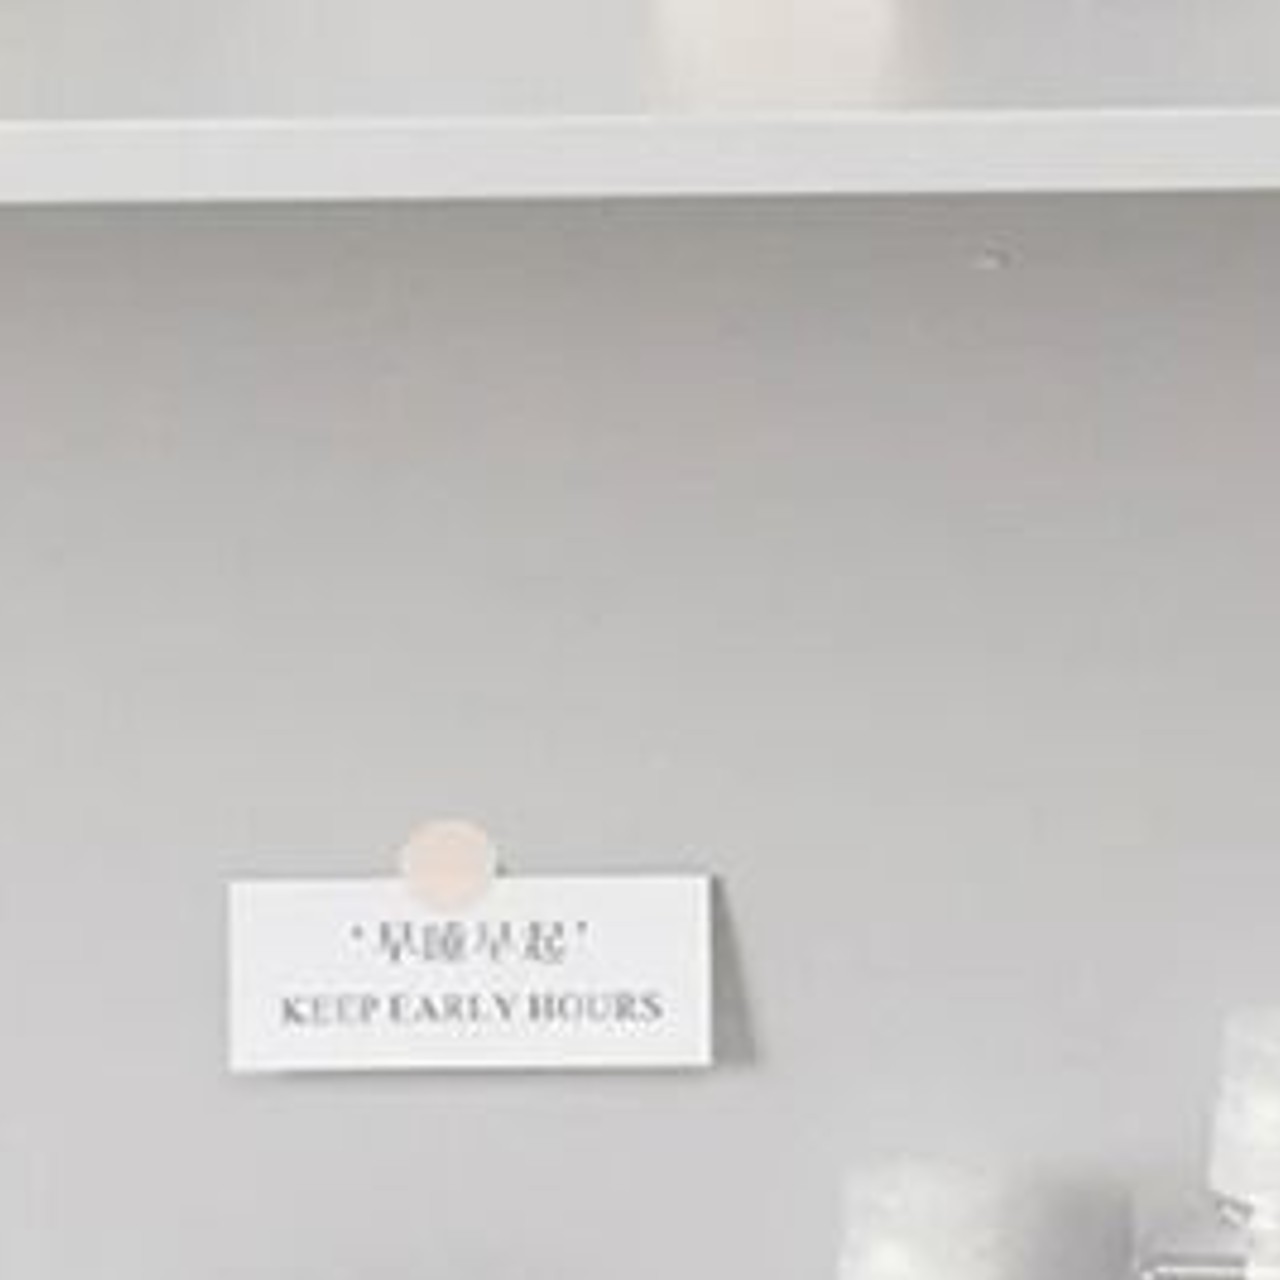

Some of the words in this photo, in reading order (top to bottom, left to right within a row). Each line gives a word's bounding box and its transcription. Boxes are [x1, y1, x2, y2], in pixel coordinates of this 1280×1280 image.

[280, 994, 383, 1027] KEEP
[387, 992, 518, 1026] EARLY
[527, 990, 666, 1024] HOURS
